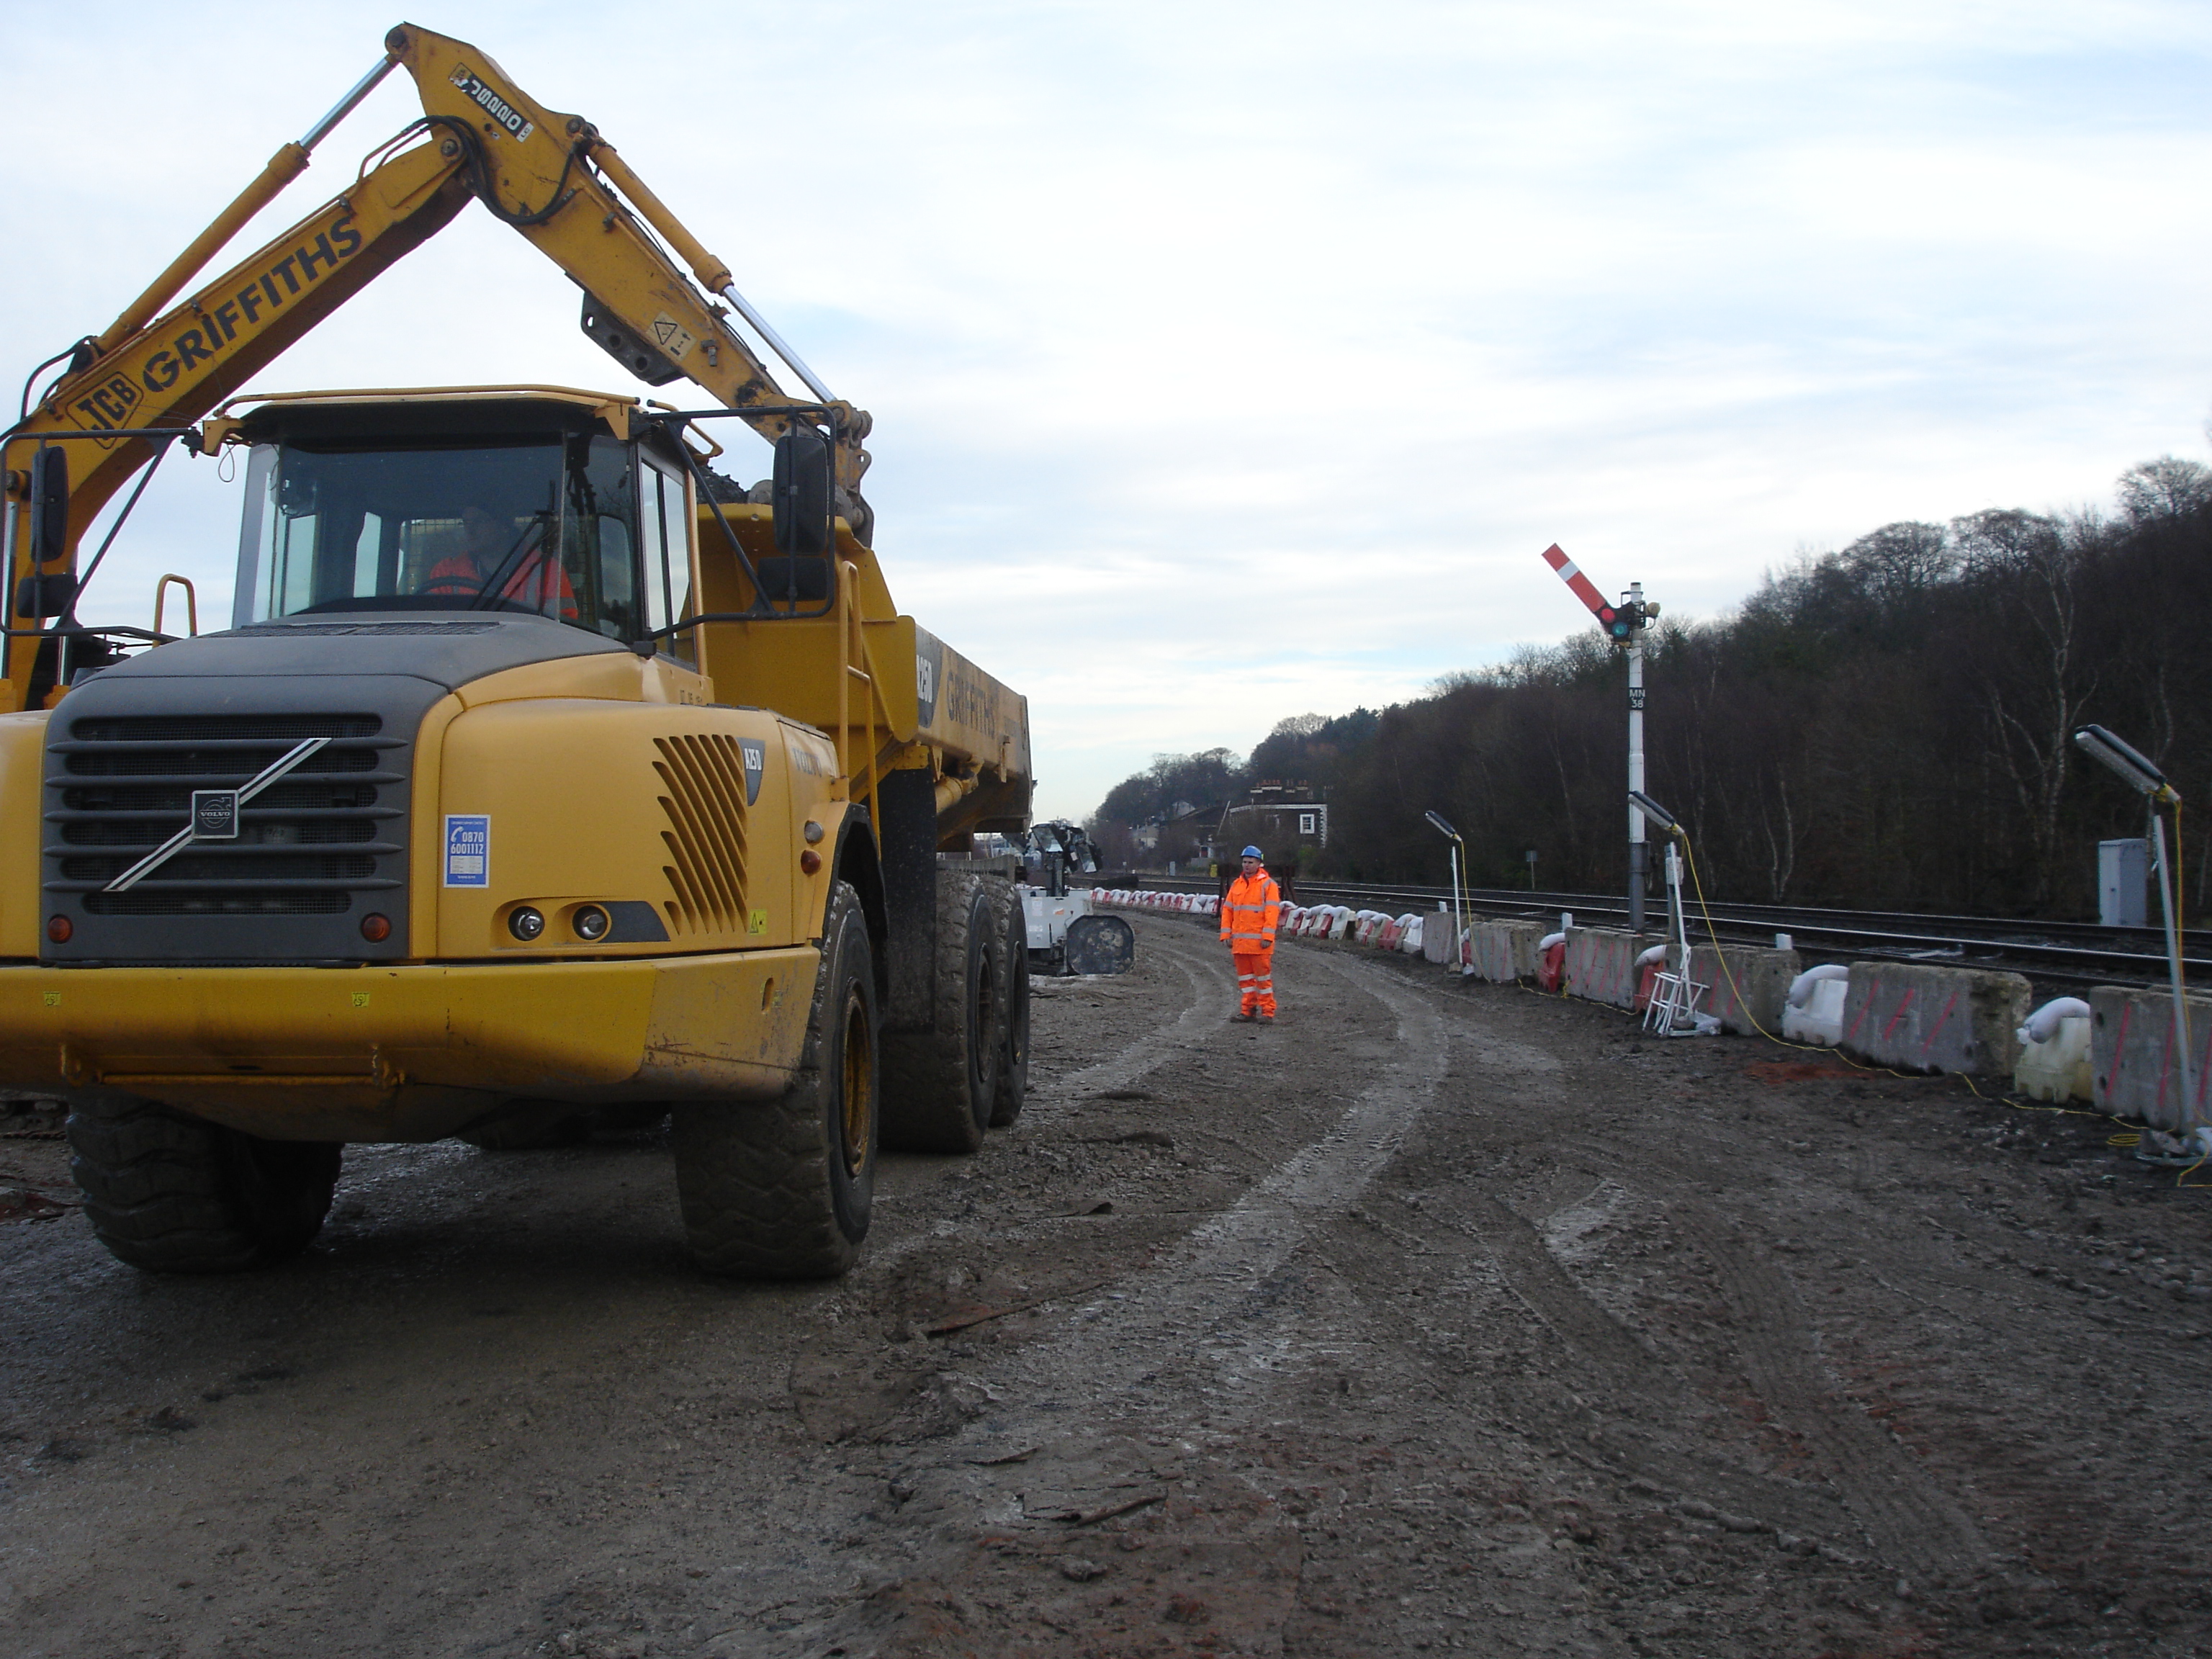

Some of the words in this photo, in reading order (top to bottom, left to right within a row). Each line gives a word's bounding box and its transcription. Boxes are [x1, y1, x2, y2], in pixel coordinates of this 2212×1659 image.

[471, 79, 521, 130] JS220
[143, 216, 362, 392] GRIFFITHS
[76, 379, 137, 441] JCB
[1631, 699, 1644, 709] 38
[450, 843, 484, 855] 6001112
[462, 831, 484, 842] 0870
